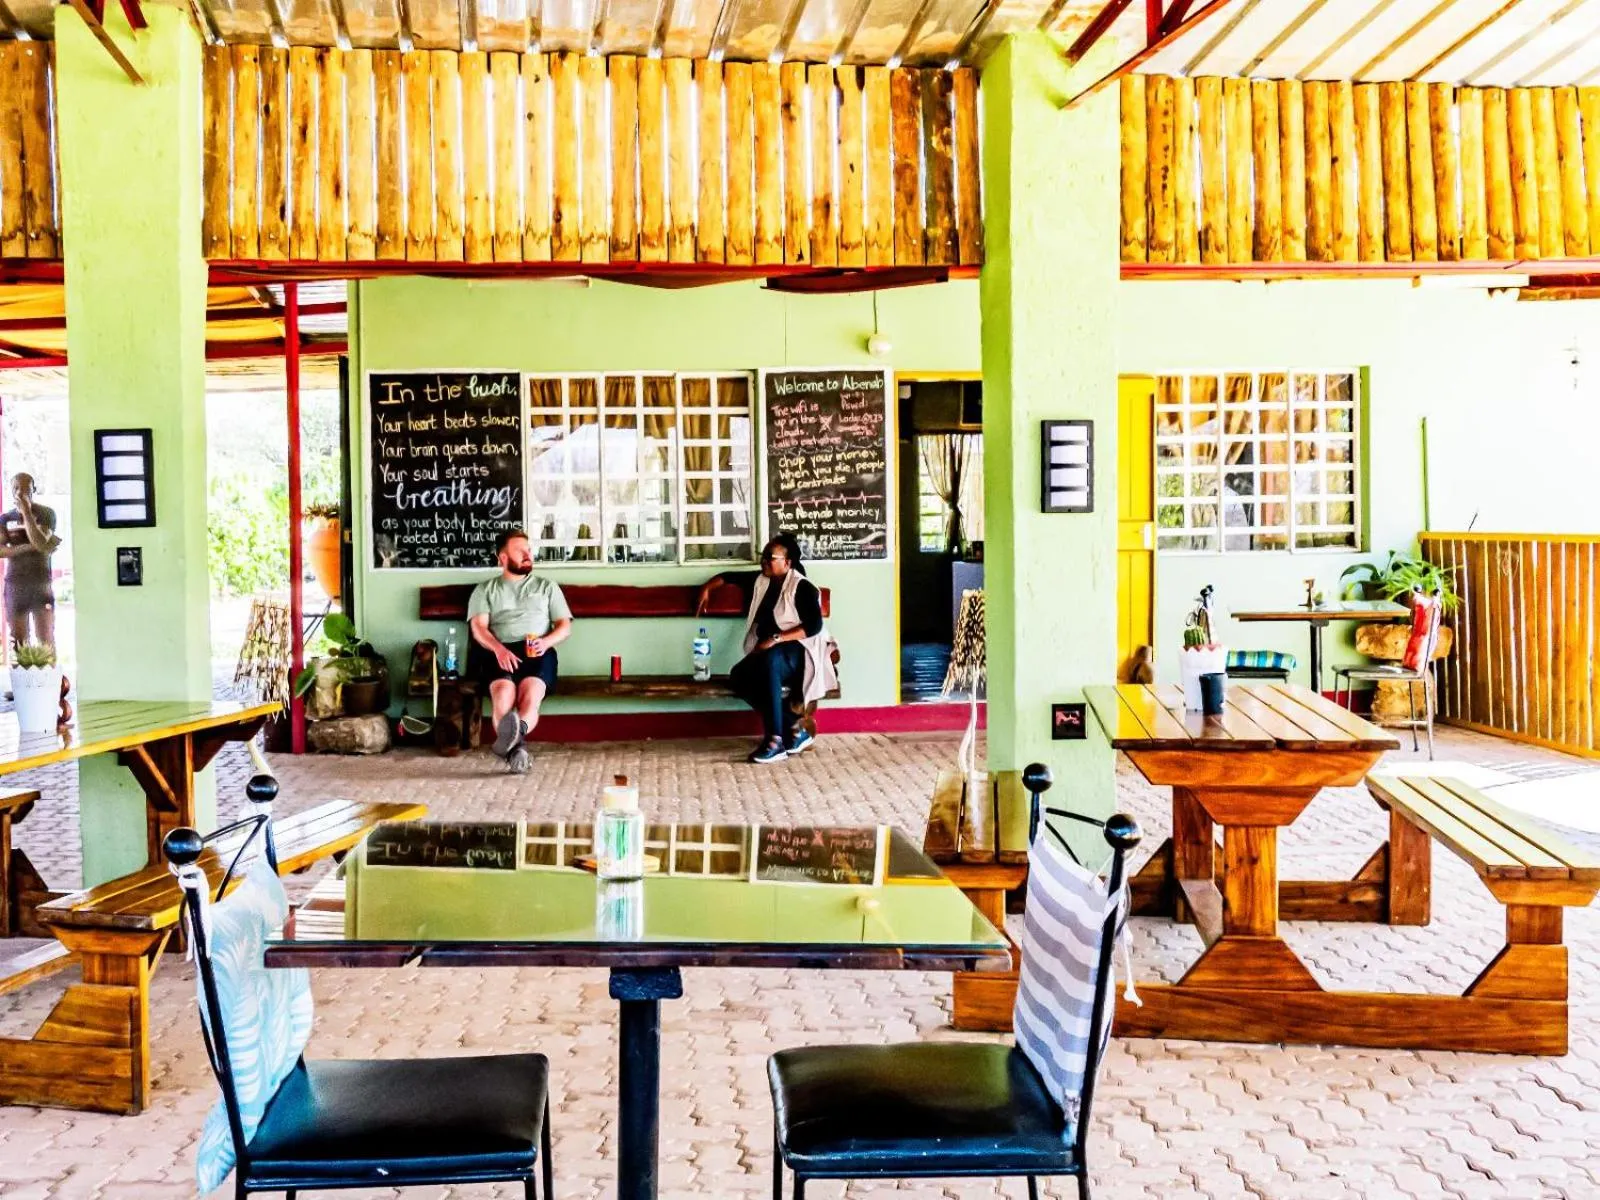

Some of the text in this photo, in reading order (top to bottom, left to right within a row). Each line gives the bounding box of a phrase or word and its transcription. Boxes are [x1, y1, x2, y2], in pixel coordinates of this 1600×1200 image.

[378, 382, 415, 405] In
[423, 375, 462, 402] the
[774, 374, 883, 395] Welcome to Abenab
[376, 413, 403, 434] Your
[407, 410, 437, 432] heart
[444, 409, 477, 430] beats
[378, 438, 405, 459] Your
[409, 437, 438, 458] brain
[811, 453, 833, 468] your
[813, 466, 832, 479] you
[856, 459, 885, 474] people
[379, 460, 490, 484] Your soul starts
[772, 508, 793, 520] The
[836, 504, 880, 522] monkey
[381, 517, 399, 530] as
[403, 517, 431, 535] your
[435, 511, 466, 537] body
[394, 529, 500, 548] rooted in natur
[416, 547, 449, 556] once
